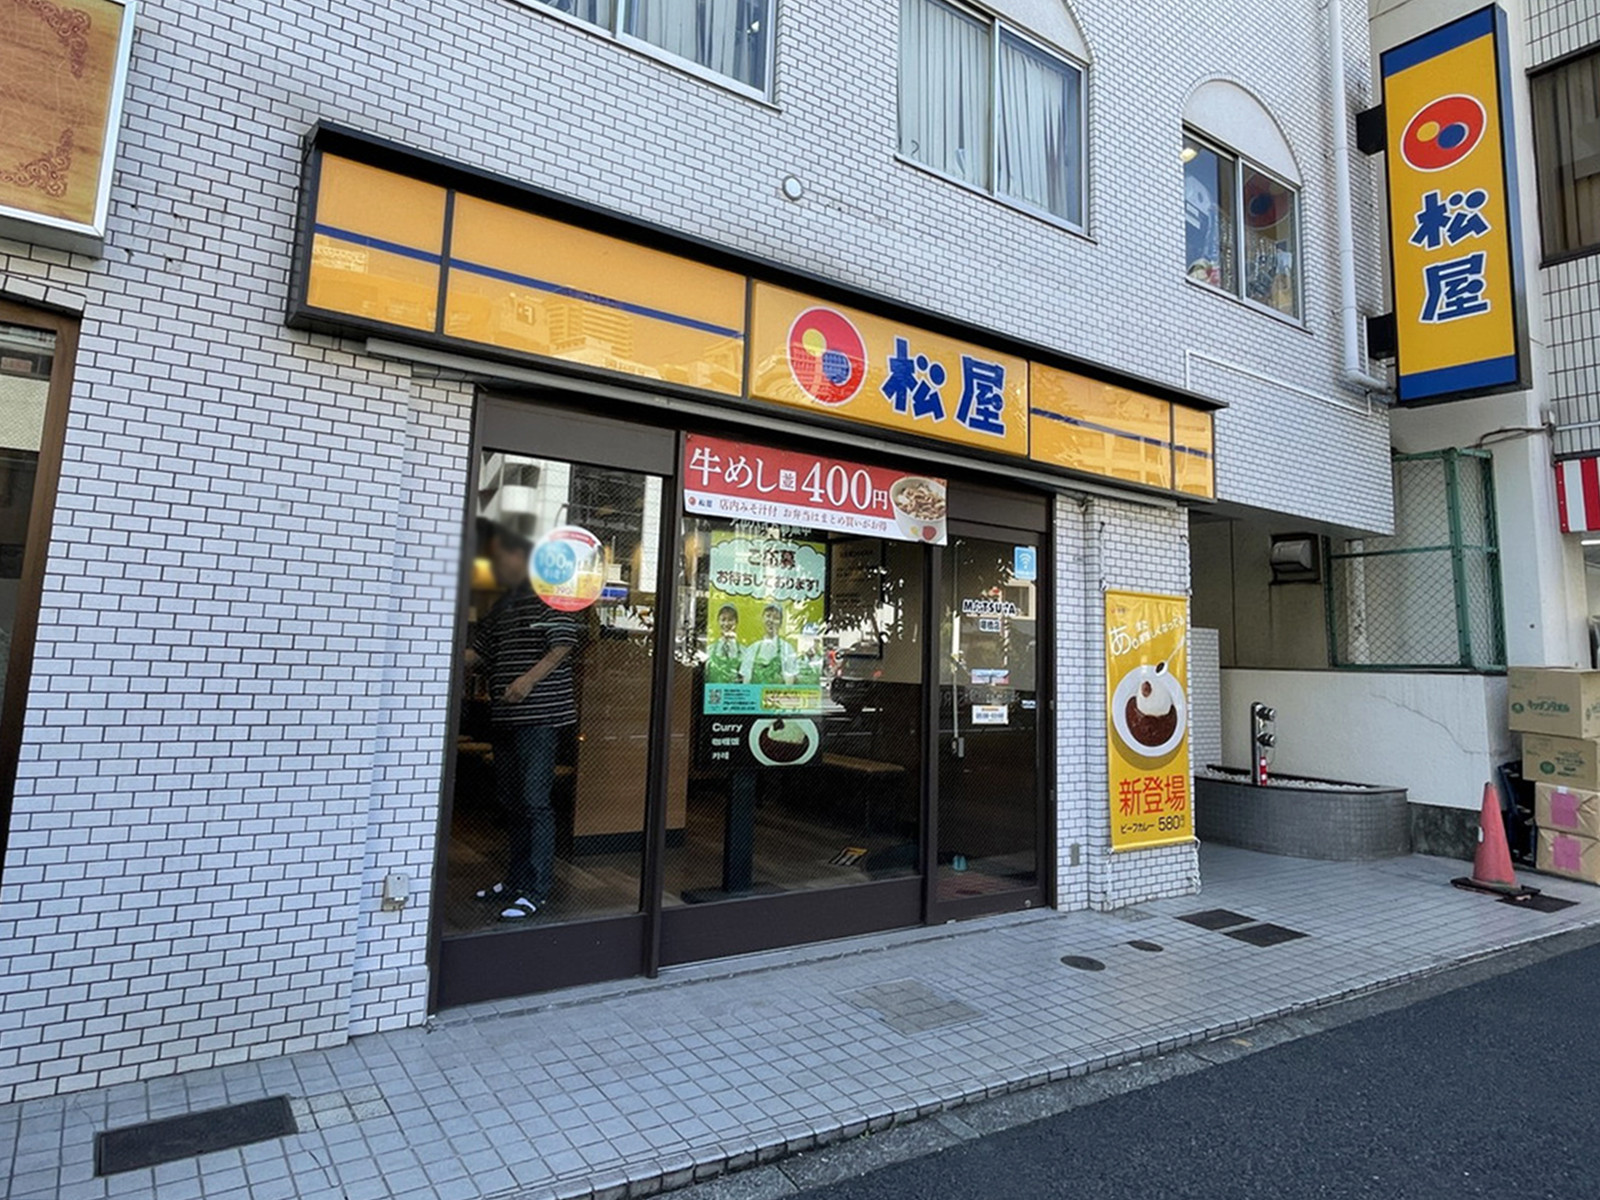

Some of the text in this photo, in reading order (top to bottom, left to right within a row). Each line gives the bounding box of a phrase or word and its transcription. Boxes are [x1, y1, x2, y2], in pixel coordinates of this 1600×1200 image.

[1408, 188, 1491, 324] 松屋
[880, 335, 1005, 437] 松屋
[689, 447, 777, 493] 牛めし
[801, 462, 888, 510] 400円
[720, 499, 888, 532] 店内みそ汁付 お弁当はまとめ買いがお得
[712, 722, 742, 733] Curry
[1119, 775, 1186, 817] 新登場
